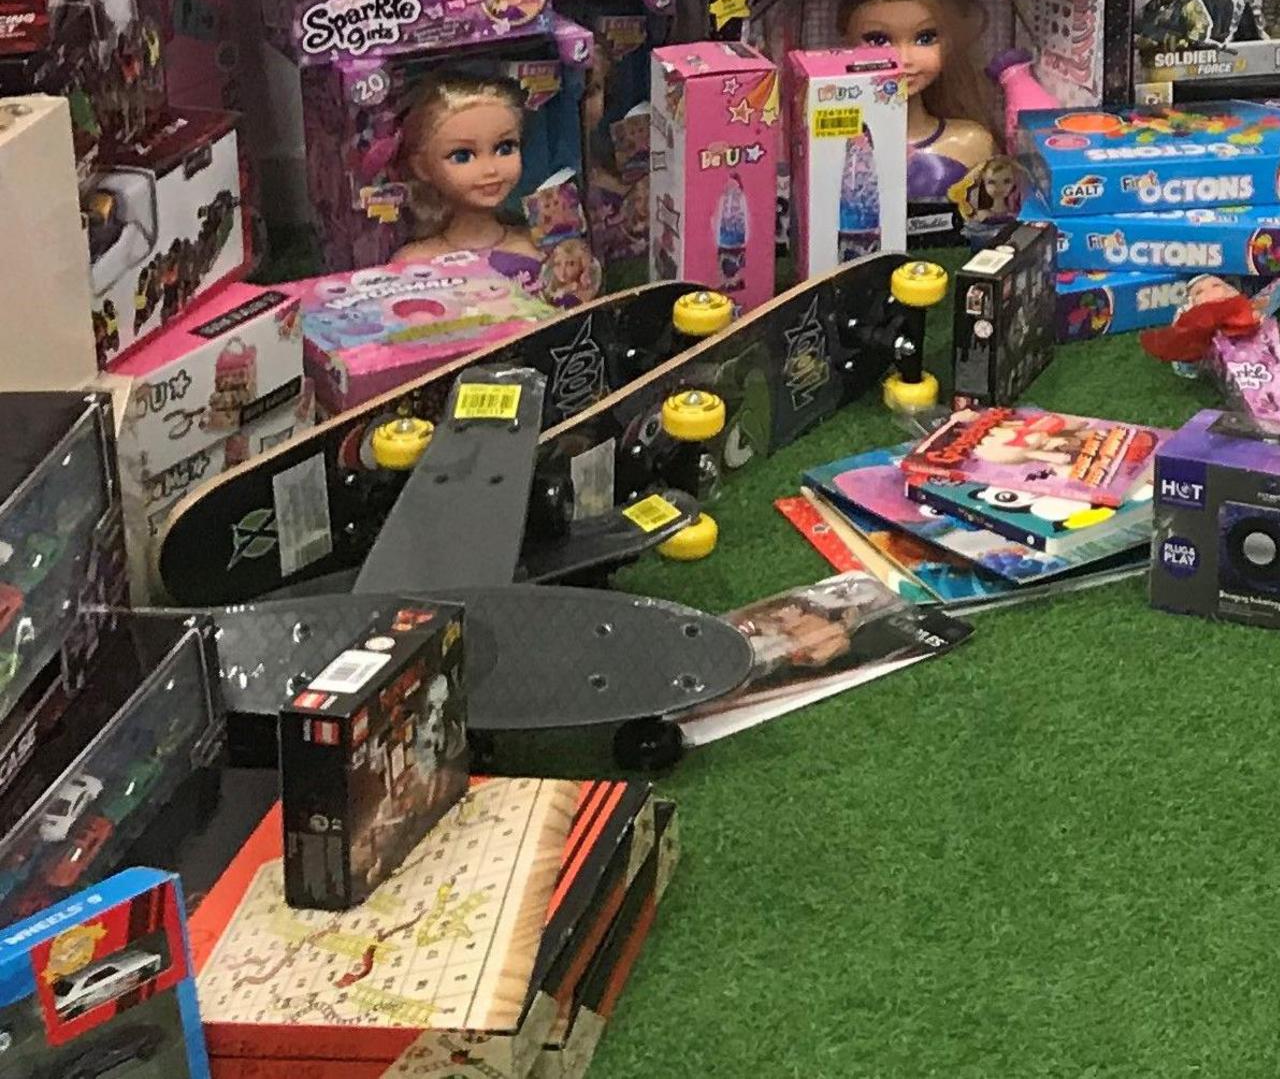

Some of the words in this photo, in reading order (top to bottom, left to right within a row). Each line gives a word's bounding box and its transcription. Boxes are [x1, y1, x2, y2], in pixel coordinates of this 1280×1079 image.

[1154, 50, 1218, 68] SOLDIER
[355, 72, 387, 101] 20
[1061, 185, 1100, 200] GALT
[1138, 175, 1254, 204] OCTONS
[1105, 241, 1222, 268] OCTONS
[1161, 479, 1204, 501] HOT
[1163, 551, 1197, 567] PLAY
